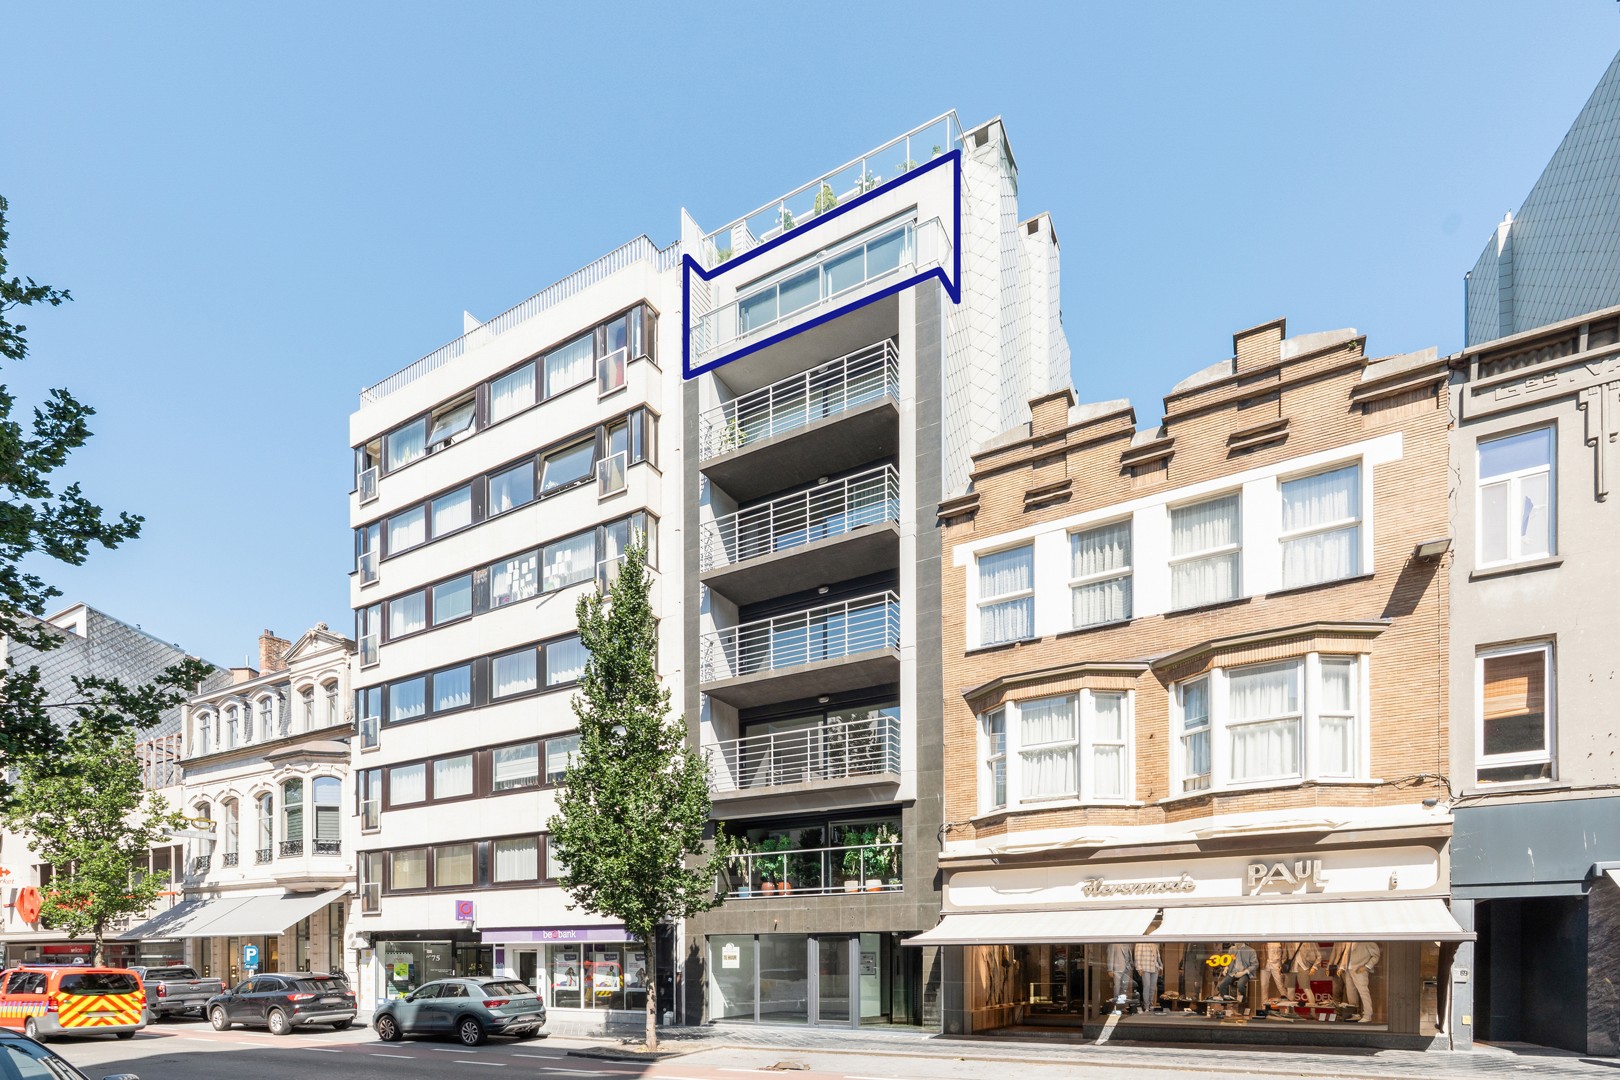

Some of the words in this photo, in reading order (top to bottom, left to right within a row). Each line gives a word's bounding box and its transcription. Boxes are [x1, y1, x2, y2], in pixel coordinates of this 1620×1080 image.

[1247, 860, 1329, 886] PAUL
[1081, 871, 1196, 898] Herenmode
[246, 948, 257, 962] P
[1295, 992, 1334, 1001] SODEN
